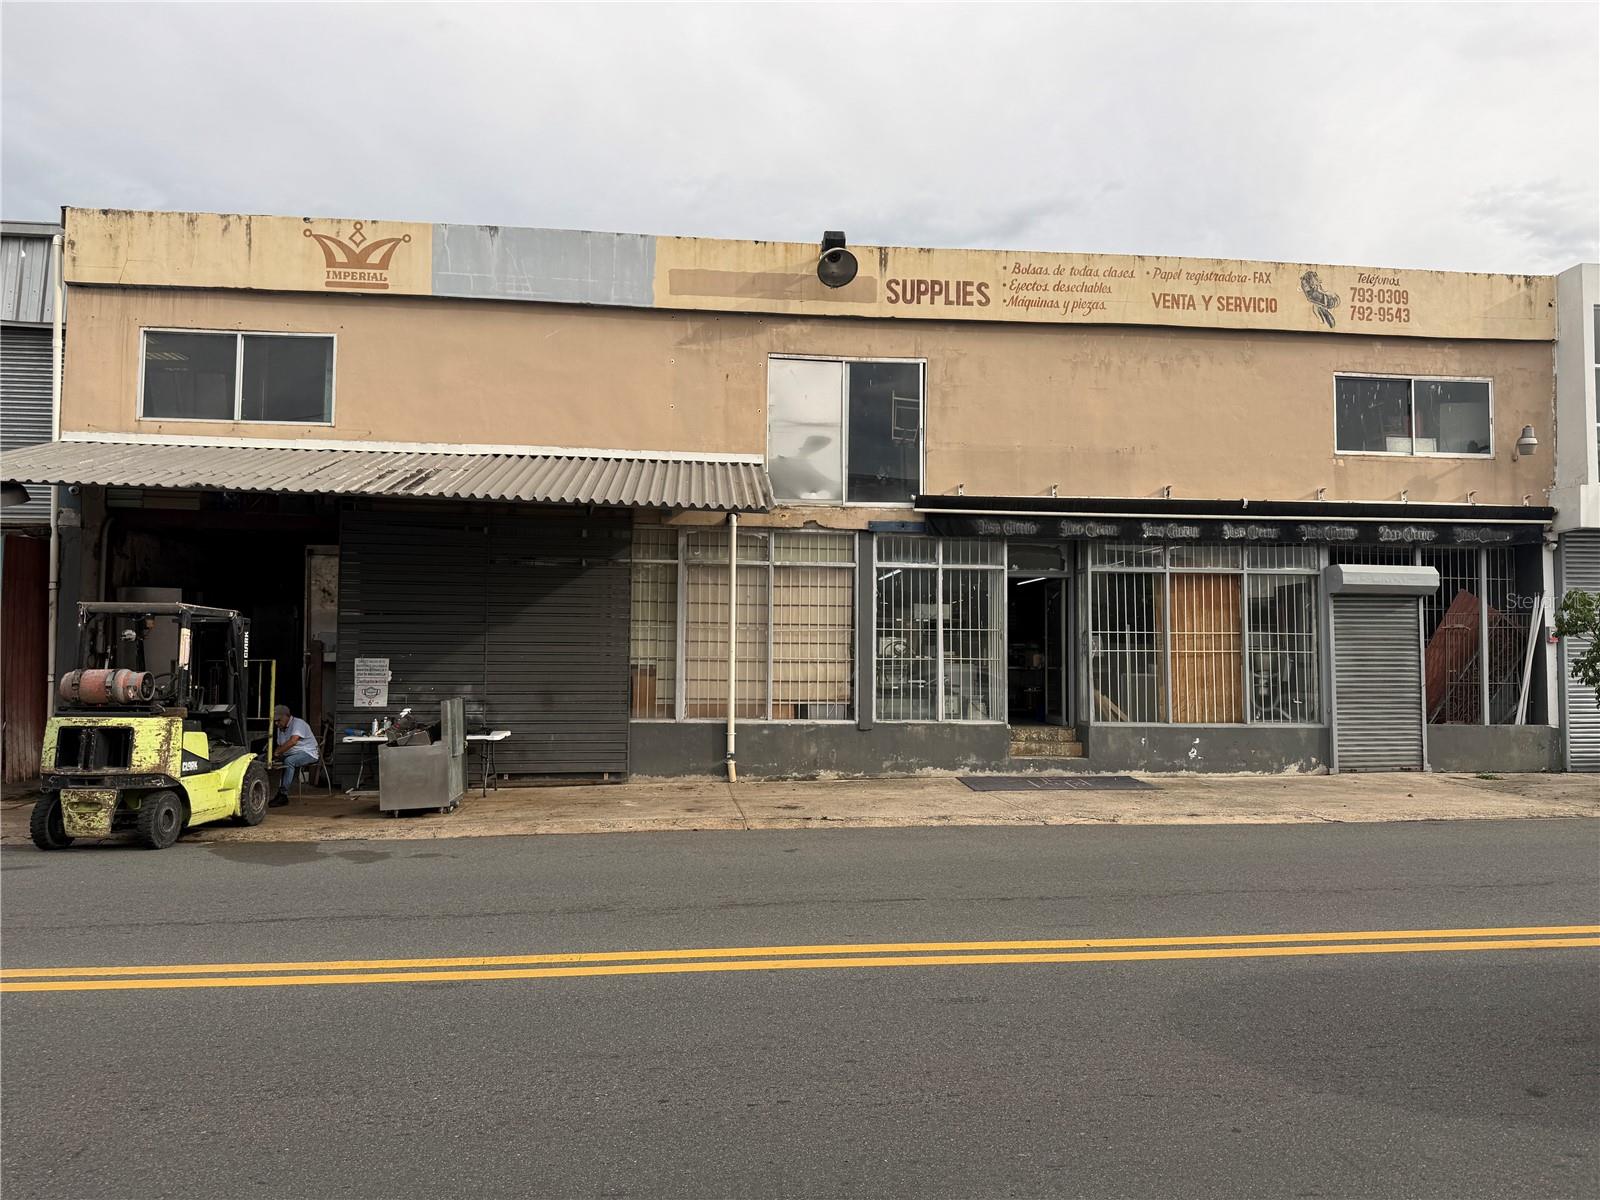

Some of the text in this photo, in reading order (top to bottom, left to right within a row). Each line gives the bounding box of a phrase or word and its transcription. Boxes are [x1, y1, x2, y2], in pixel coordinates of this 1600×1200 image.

[326, 270, 388, 281] IMPERIAL
[1011, 262, 1136, 279] Bolsas de todas clases
[1152, 267, 1182, 282] Papel
[1253, 271, 1272, 284] FAX
[1009, 278, 1113, 294] Efectos desechables
[1357, 272, 1401, 287] Teléfonos
[886, 278, 991, 307] SUPPLIES
[1350, 287, 1409, 305] 793-0309
[1006, 295, 1107, 316] Máquinas y piezas
[1152, 292, 1278, 313] VENTA Y SERVICIO
[1350, 305, 1410, 323] 792-9543
[182, 760, 198, 772] CLARK
